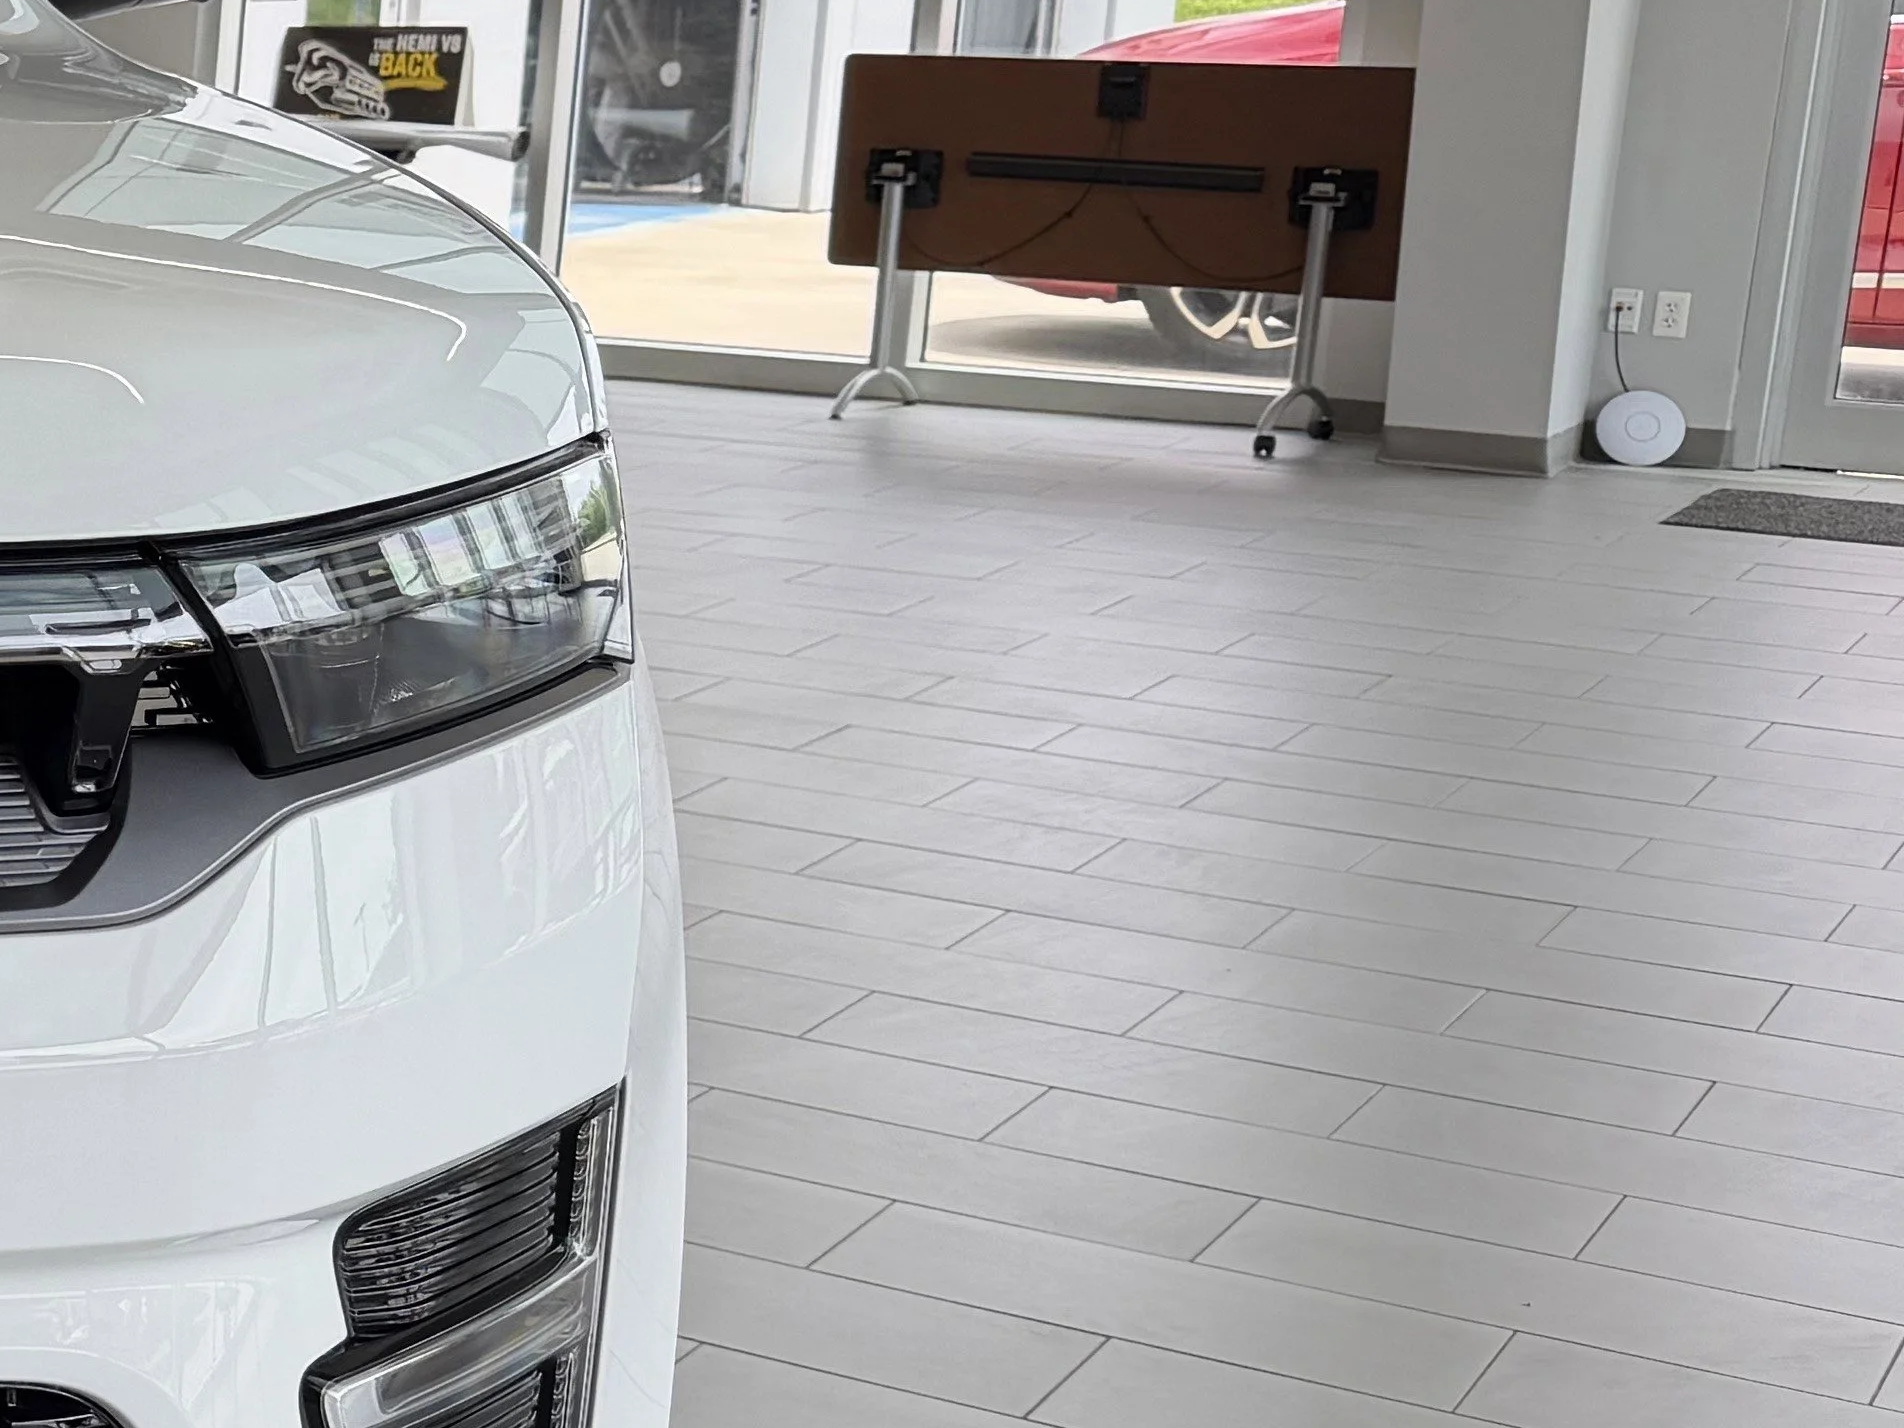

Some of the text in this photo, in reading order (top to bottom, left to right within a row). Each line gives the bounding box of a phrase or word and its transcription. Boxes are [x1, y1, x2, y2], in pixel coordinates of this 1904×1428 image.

[395, 33, 438, 52] HEMI
[442, 34, 462, 53] V8
[379, 51, 438, 77] BACK
